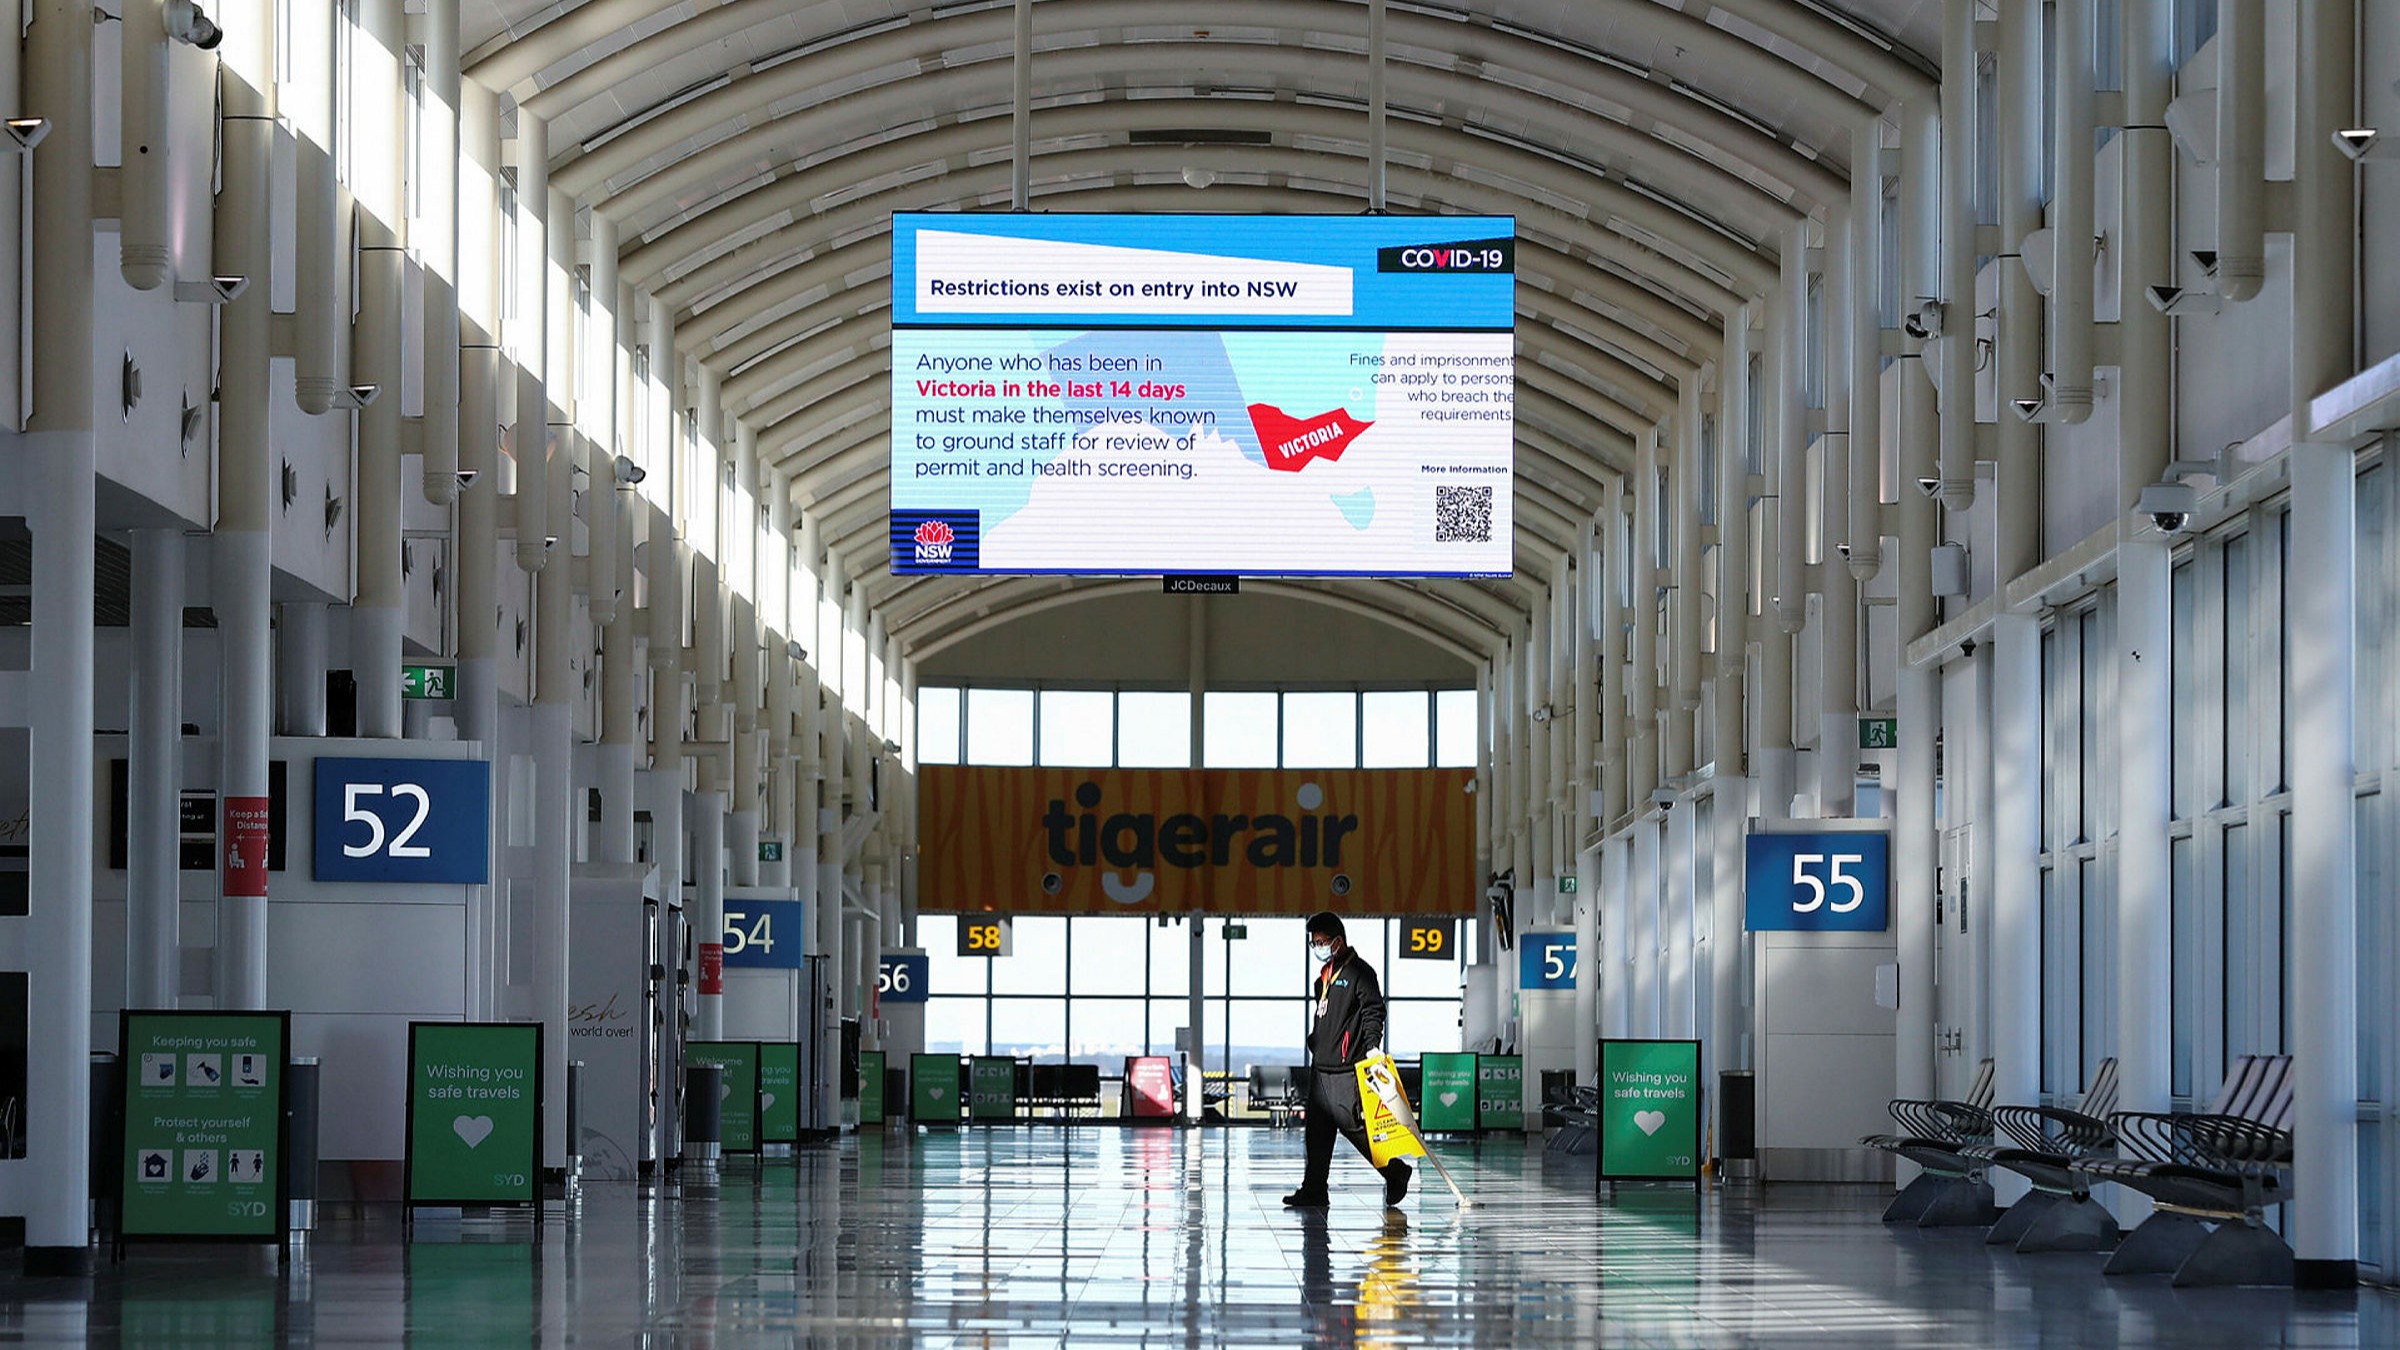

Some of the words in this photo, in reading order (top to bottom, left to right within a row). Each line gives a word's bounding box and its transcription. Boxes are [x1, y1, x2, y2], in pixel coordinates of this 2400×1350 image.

[1401, 248, 1503, 268] COVID-19
[930, 279, 1050, 297] Restrictions
[1056, 280, 1102, 297] exist
[1109, 283, 1135, 298] on
[1142, 281, 1194, 300] entry
[1201, 280, 1240, 298] into
[1247, 282, 1298, 298] NSW
[916, 354, 993, 374] Anyone
[1000, 354, 1042, 372] who
[1049, 354, 1082, 372] has
[1088, 354, 1138, 372] been
[1146, 354, 1162, 372] in
[1350, 353, 1385, 366] Fines
[1390, 354, 1416, 366] and
[1420, 354, 1515, 368] imprisonment
[1371, 374, 1396, 384] can
[1400, 372, 1438, 386] apply
[1442, 374, 1457, 384] to
[1461, 374, 1515, 386] persons
[916, 380, 996, 397] Victoria
[1003, 380, 1020, 397] in
[1028, 380, 1061, 398] the
[1068, 380, 1104, 398] last
[1110, 381, 1132, 398] 14
[1138, 380, 1186, 400] days
[1408, 390, 1437, 402] who
[1442, 390, 1488, 402] breach
[1493, 390, 1515, 402] the
[916, 408, 965, 424] must
[972, 406, 1026, 424] make
[1032, 406, 1142, 424] themselves
[1150, 407, 1216, 424] known
[916, 435, 935, 450] to
[942, 433, 1014, 452] ground
[1021, 432, 1066, 450] staff
[1072, 432, 1098, 450] for
[1106, 434, 1170, 450] review
[1176, 432, 1198, 450] of
[1278, 421, 1344, 459] VICTORIA
[916, 459, 980, 479] permit
[986, 459, 1024, 476] and
[1032, 459, 1092, 476] health
[1098, 460, 1198, 480] screening.
[1421, 465, 1447, 474] More
[1449, 465, 1508, 474] Information
[915, 544, 952, 558] NSW
[1170, 580, 1232, 591] JCDecaux
[229, 810, 252, 820] Keep
[344, 784, 430, 858] 52
[1042, 782, 1358, 904] tigerair
[1792, 854, 1864, 913] 55
[723, 912, 774, 954] 54
[968, 926, 1000, 949] 58
[1410, 928, 1442, 952] 59
[878, 964, 910, 992] 56
[570, 1026, 602, 1037] world
[605, 1026, 634, 1038] over!
[152, 1036, 202, 1048] Keeping
[206, 1038, 228, 1048] you
[231, 1036, 256, 1047] safe
[426, 1064, 490, 1081] Wishing
[494, 1068, 524, 1082] you
[1612, 1072, 1662, 1086] Wishing
[1664, 1074, 1687, 1086] you
[428, 1084, 462, 1098] safe
[467, 1085, 520, 1099] travels
[1614, 1087, 1640, 1098] safe
[1644, 1088, 1686, 1099] travels
[154, 1116, 198, 1128] Protect
[200, 1116, 250, 1130] yourself
[176, 1132, 186, 1143] &
[188, 1132, 228, 1143] others
[494, 1174, 525, 1186] SYD
[228, 1200, 266, 1217] SYD
